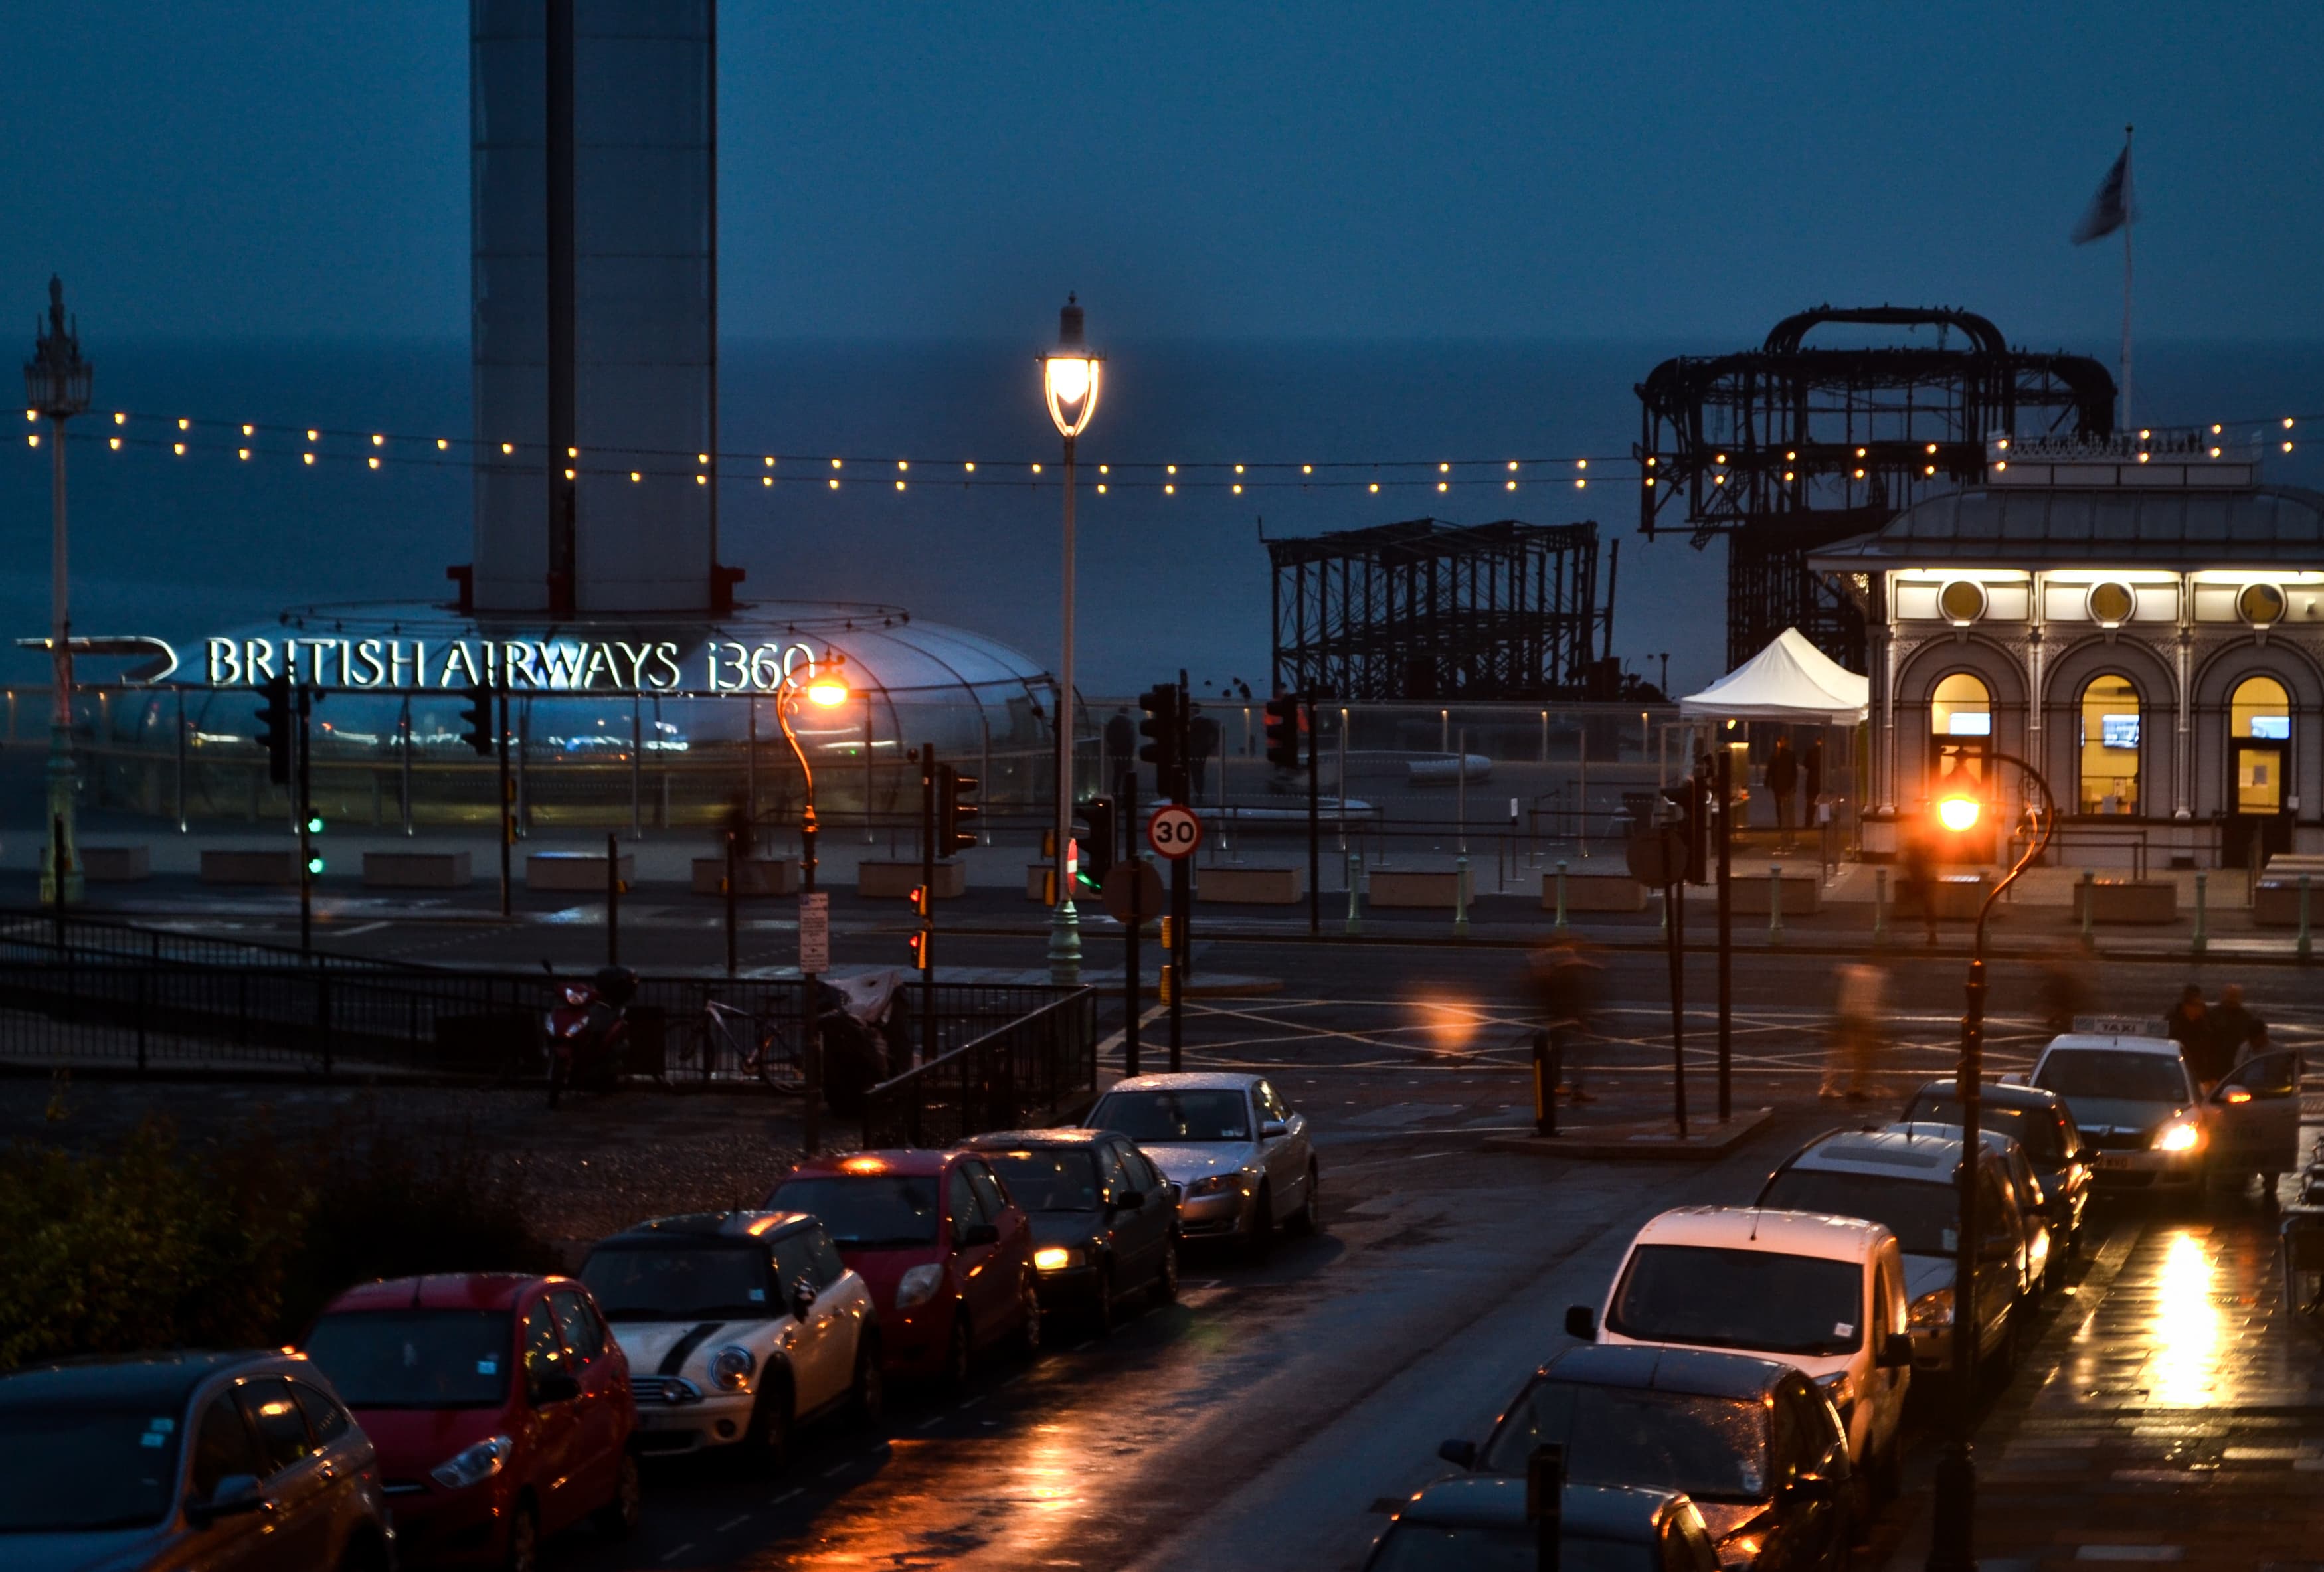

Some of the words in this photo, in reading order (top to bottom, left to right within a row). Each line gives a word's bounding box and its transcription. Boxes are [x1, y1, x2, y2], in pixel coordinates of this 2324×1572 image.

[207, 636, 425, 688] BRITISH
[440, 640, 681, 689] AIRWAYS
[708, 642, 816, 691] i360
[1156, 821, 1194, 843] 30
[2102, 1023, 2137, 1033] TAXI
